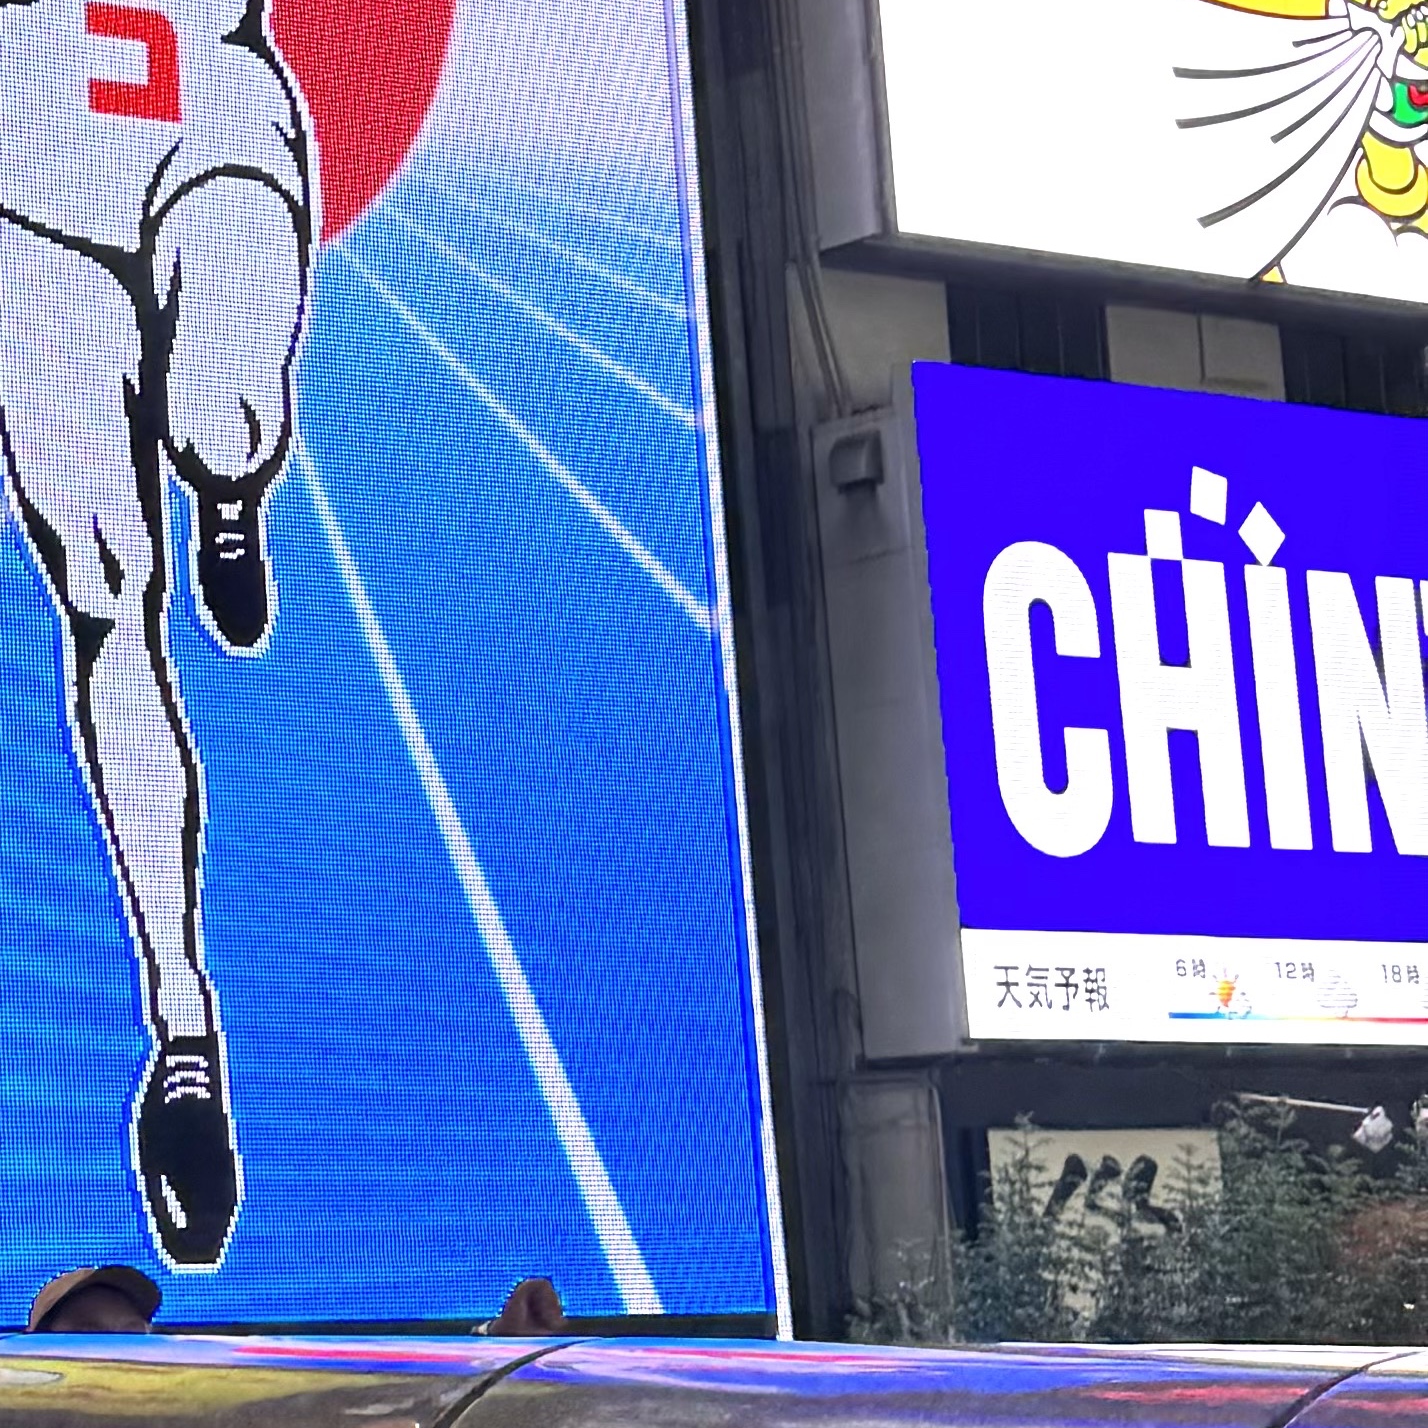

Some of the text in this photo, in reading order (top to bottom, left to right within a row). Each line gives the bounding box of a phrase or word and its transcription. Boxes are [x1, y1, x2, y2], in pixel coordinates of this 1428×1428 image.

[982, 465, 1428, 859] CHIN
[993, 965, 1110, 1013] 天気予報
